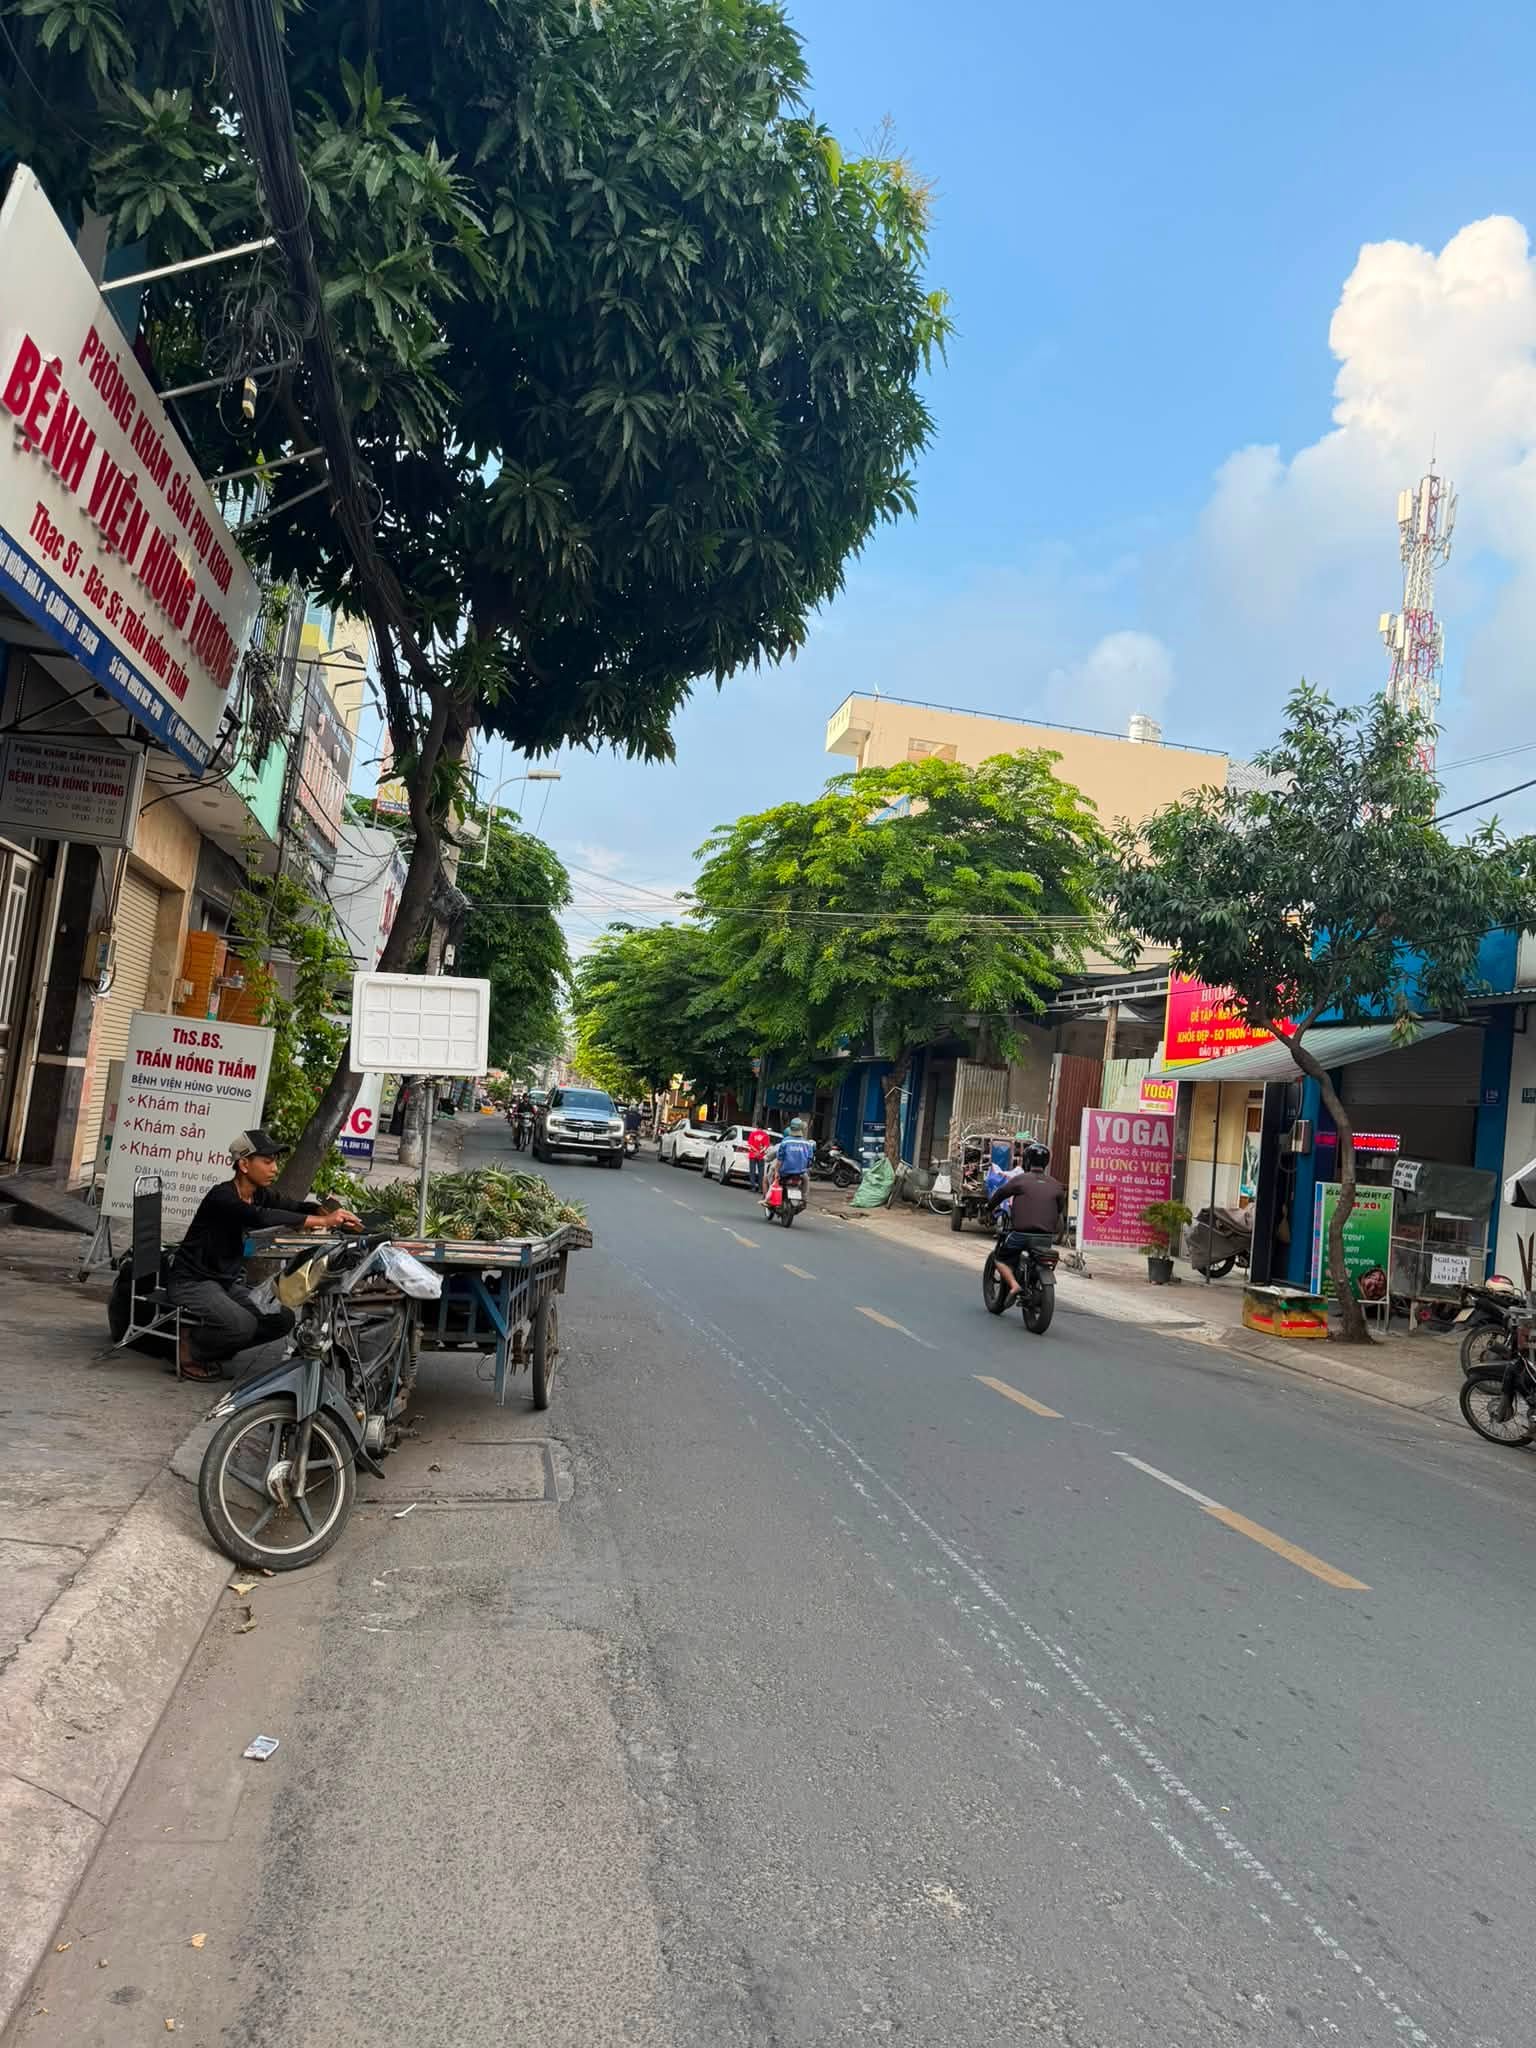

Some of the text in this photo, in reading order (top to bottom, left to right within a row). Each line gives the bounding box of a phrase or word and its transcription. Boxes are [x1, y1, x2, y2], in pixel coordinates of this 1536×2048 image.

[78, 324, 234, 596] PHÒNG KHÁM SẢN PHỤ KHOA
[2, 333, 97, 494] BỆNH
[88, 449, 150, 566] VIỆN
[138, 525, 196, 631] HÙNG
[188, 595, 240, 691] VƯƠNG
[29, 500, 65, 561] Thạc
[62, 540, 84, 578] Sĩ
[82, 564, 109, 610] Bác
[104, 591, 123, 628] Sĩ:
[37, 771, 60, 789] VIỆN
[172, 1027, 223, 1049] ThS.BS.
[1214, 1029, 1225, 1041] EO
[1225, 1027, 1246, 1041] THON
[218, 1057, 257, 1080] THẮM
[131, 1072, 252, 1098] BỆNH VIỆN HÙNG VƯƠNG
[1144, 1083, 1174, 1100] YOGA
[137, 1093, 211, 1116] Khám thai
[133, 1117, 206, 1139] Khám sản
[1095, 1116, 1170, 1148] YOGA
[129, 1140, 172, 1159] Khám
[175, 1147, 203, 1165] phụ
[1095, 1144, 1130, 1156] Aerobic
[1089, 1156, 1170, 1177] HƯƠNG VIỆT
[179, 1183, 197, 1193] 898
[1150, 1178, 1165, 1186] CAO
